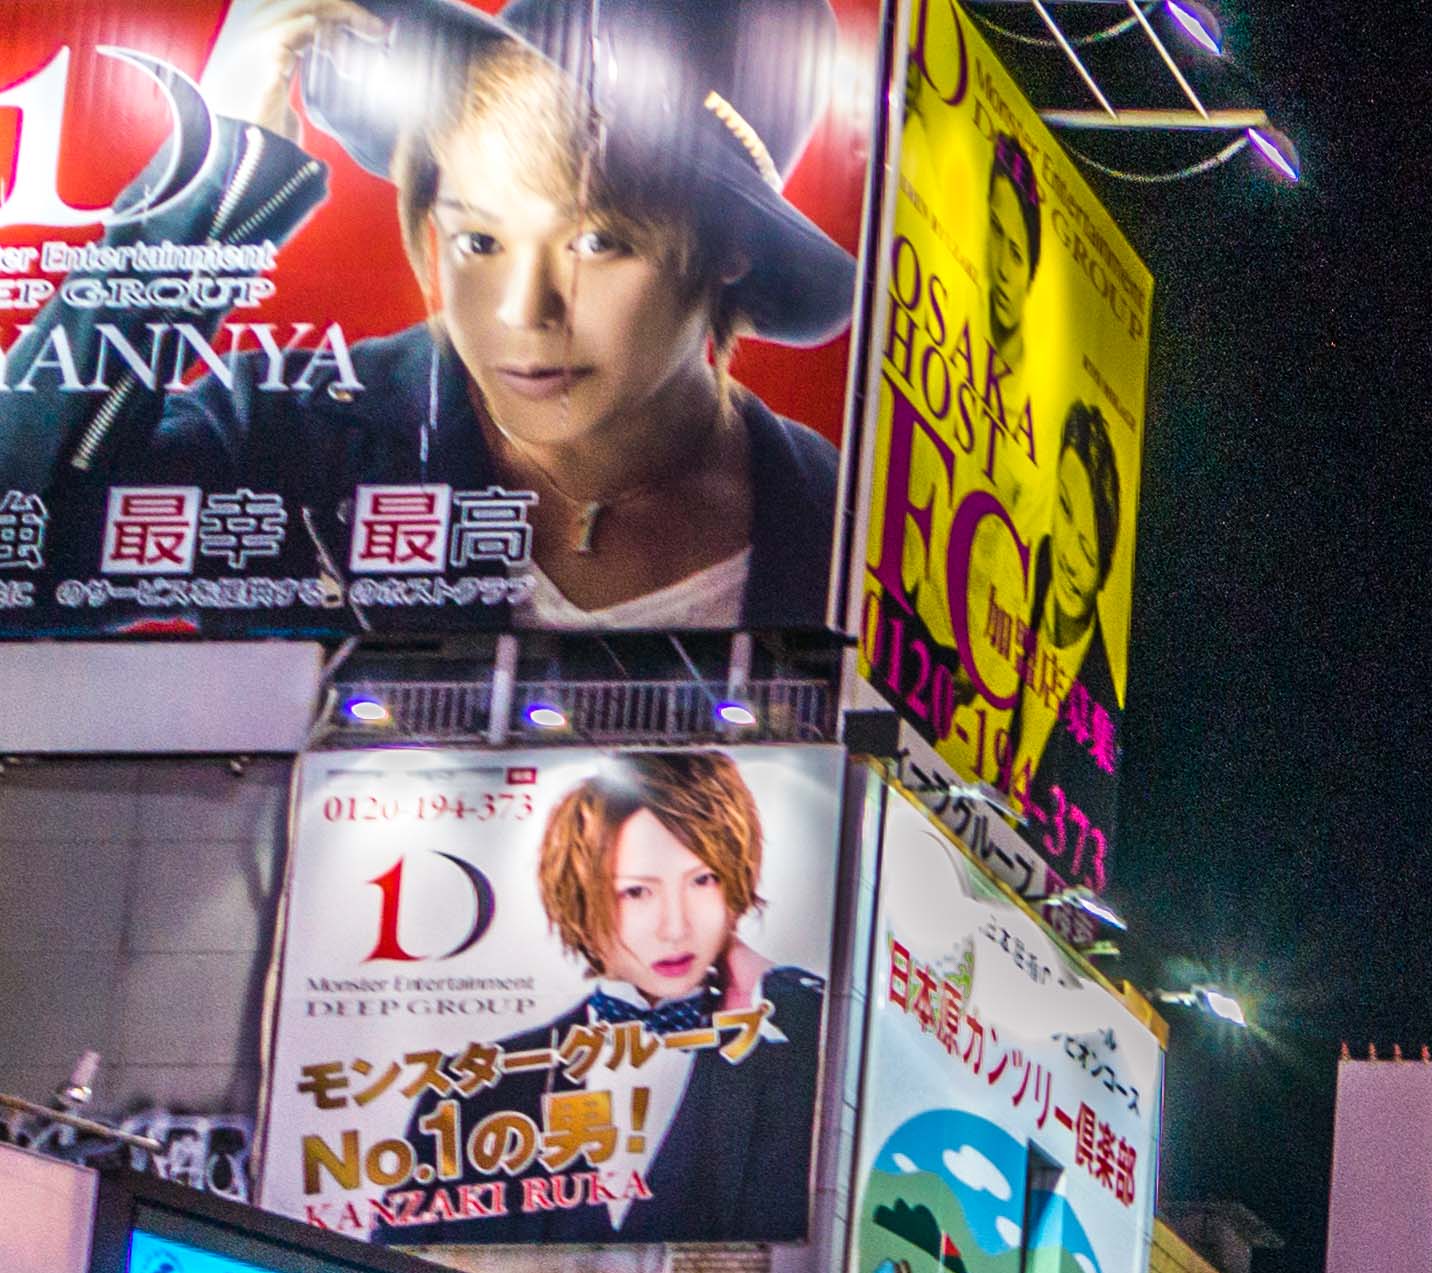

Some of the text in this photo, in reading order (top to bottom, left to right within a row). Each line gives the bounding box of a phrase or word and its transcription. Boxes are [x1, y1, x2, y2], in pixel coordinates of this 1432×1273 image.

[63, 278, 276, 310] GROUP
[883, 296, 1001, 484] HOST
[890, 233, 1040, 468] OSAKA
[351, 484, 539, 573] 最高
[866, 374, 1031, 710] FC
[323, 790, 537, 824] 0120-194-373
[304, 996, 536, 1018] DEEP GROUP
[305, 973, 535, 994] Monster Entertainment
[297, 1000, 777, 1112] モンスターグループ
[886, 938, 1139, 1208] 日本原カンツリー倶楽部
[303, 1168, 654, 1233] KANZAKI RUKA
